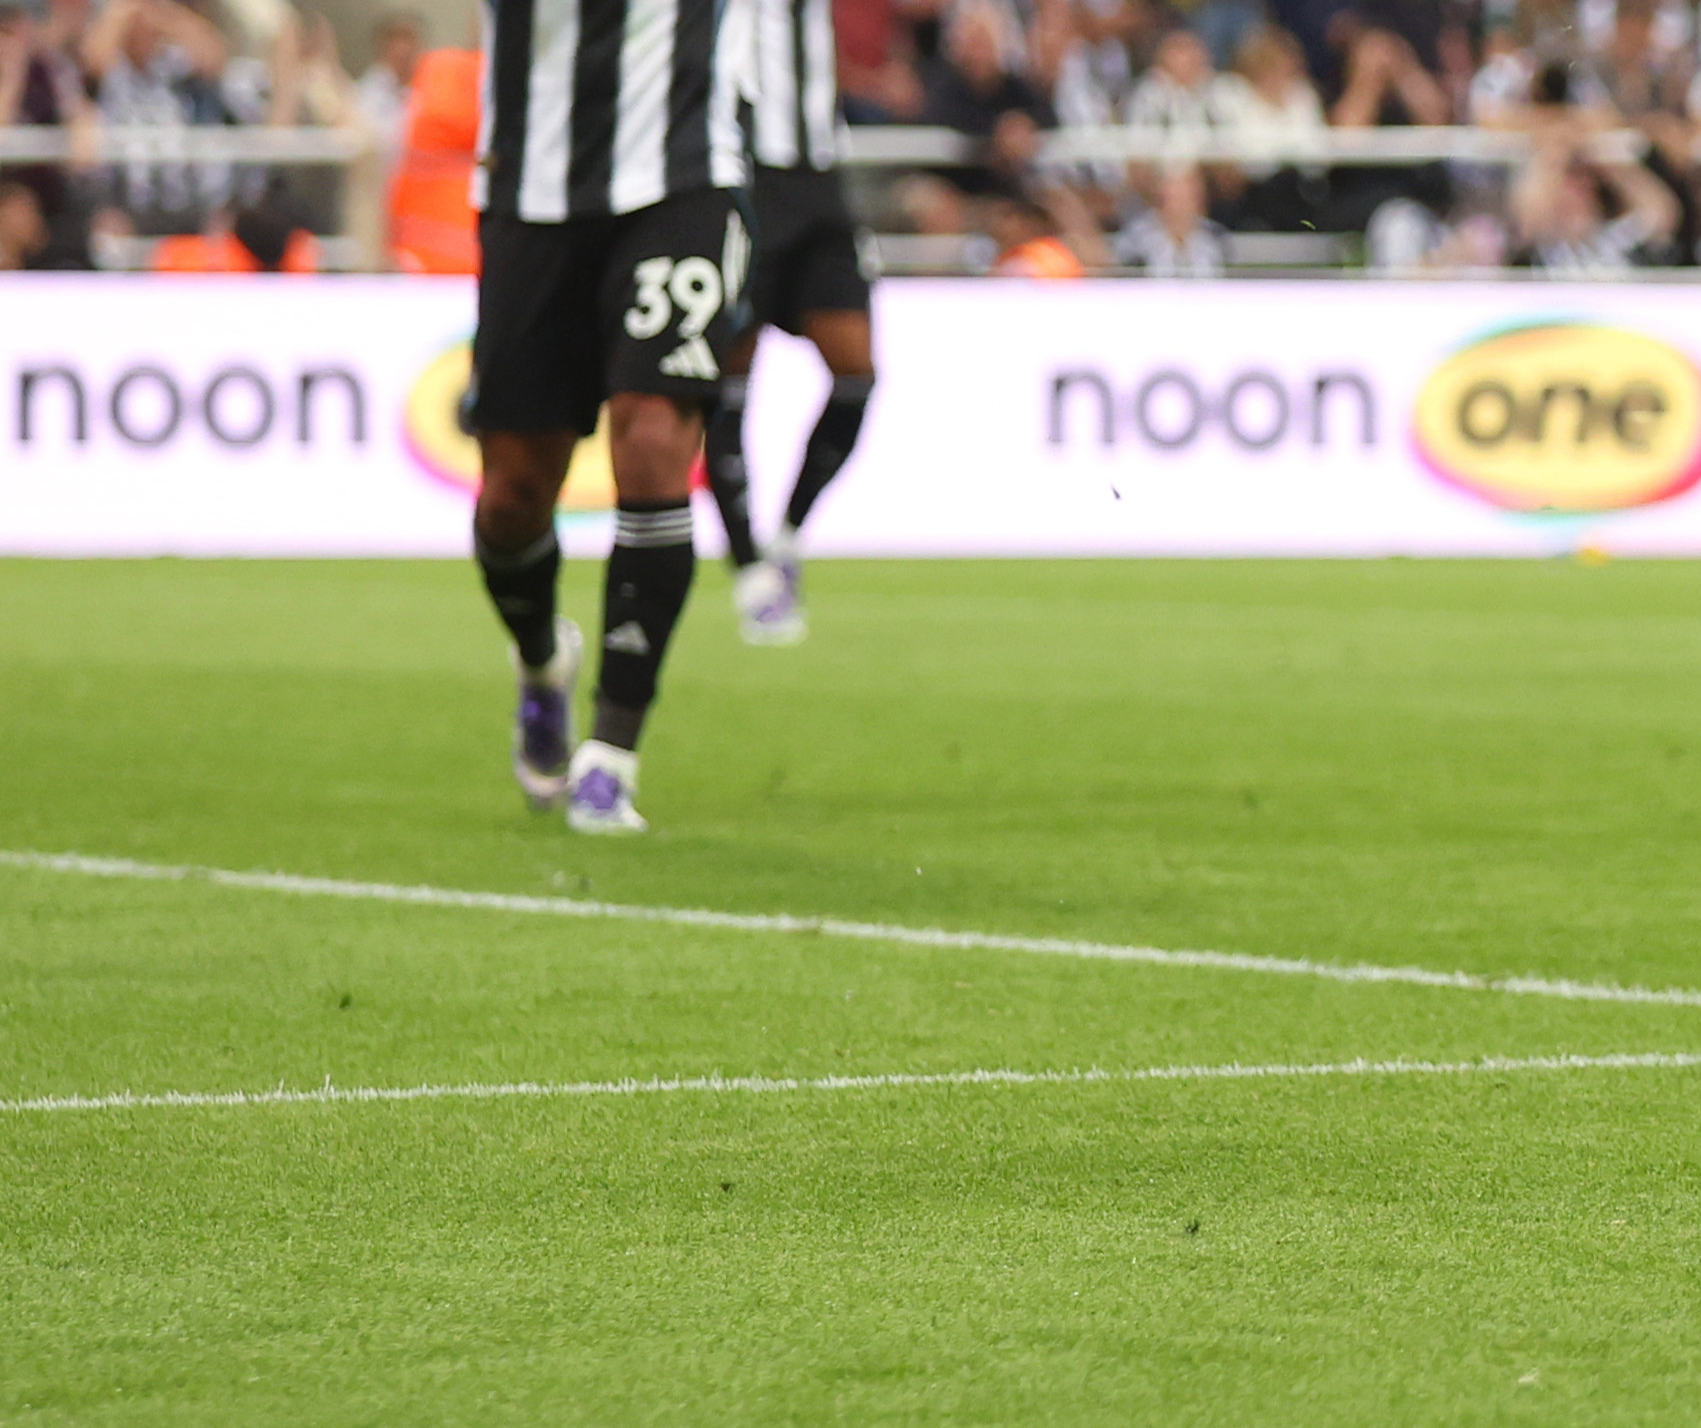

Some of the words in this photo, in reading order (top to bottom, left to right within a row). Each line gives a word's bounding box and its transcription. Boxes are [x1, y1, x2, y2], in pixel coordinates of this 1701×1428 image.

[623, 255, 724, 340] 39
[18, 367, 366, 445] noon
[1049, 369, 1377, 449] noon
[1456, 378, 1666, 452] one
